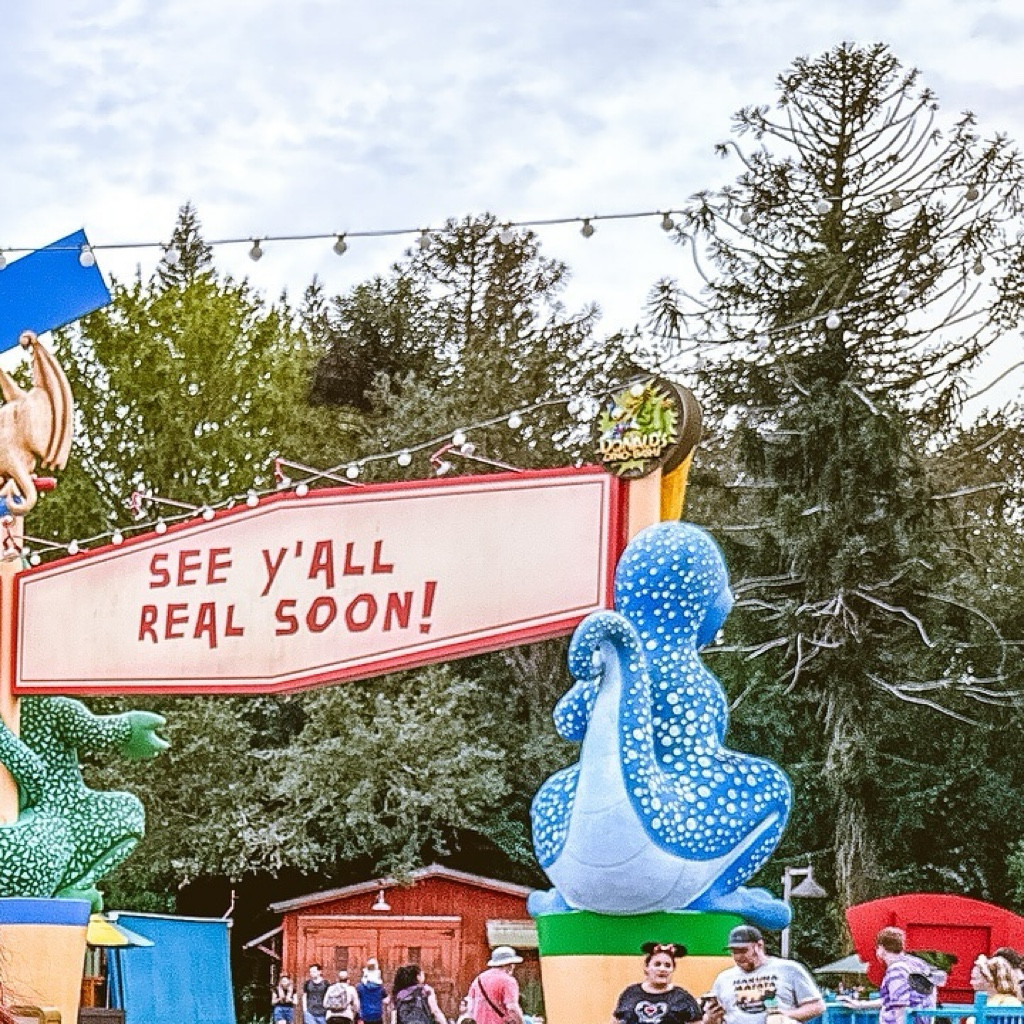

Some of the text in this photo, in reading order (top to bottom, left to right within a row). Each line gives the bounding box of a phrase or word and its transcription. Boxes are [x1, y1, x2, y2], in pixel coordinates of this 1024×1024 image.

[148, 547, 231, 588] SEE
[138, 581, 438, 648] REAL SOON!
